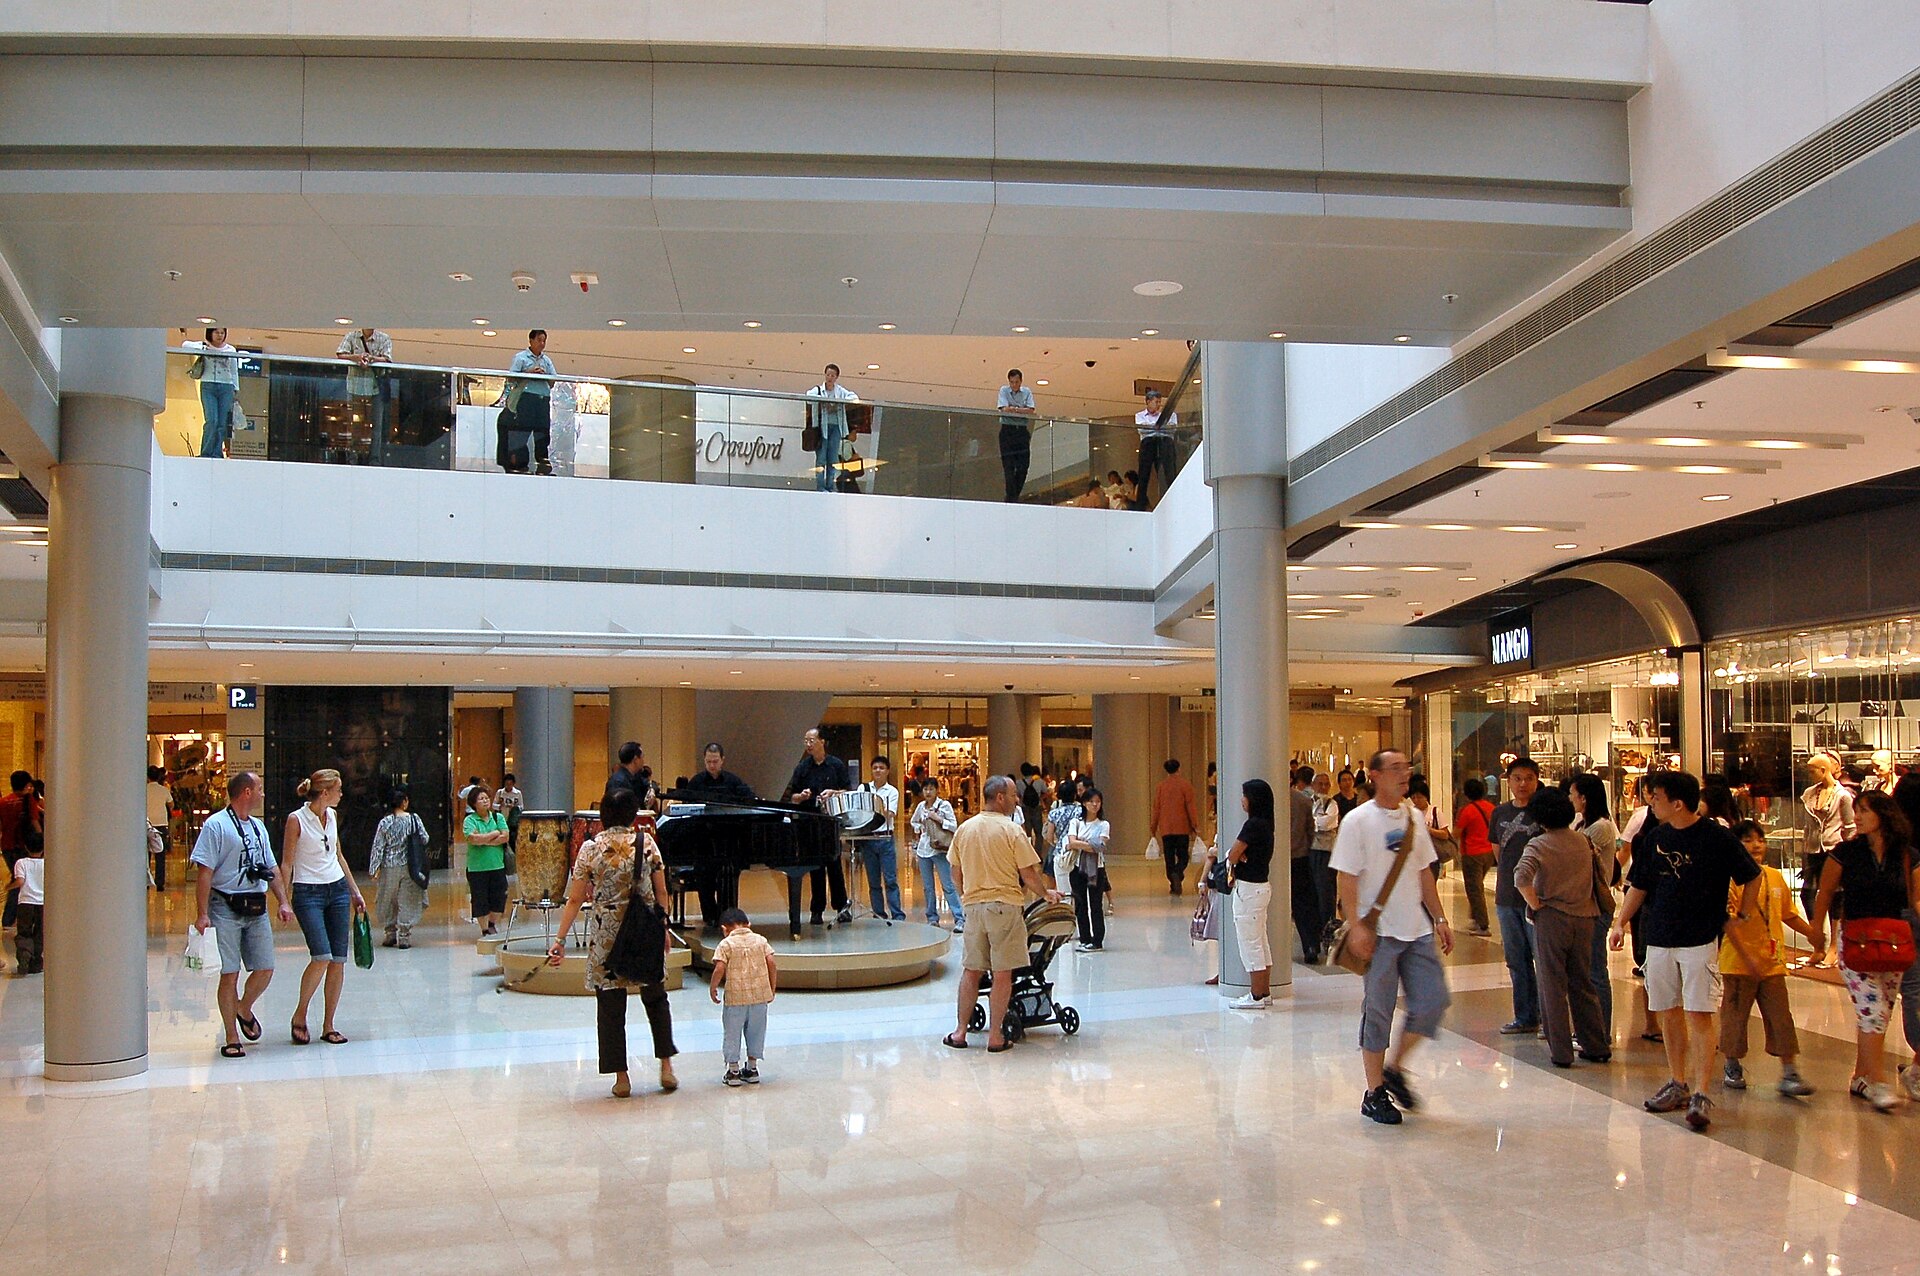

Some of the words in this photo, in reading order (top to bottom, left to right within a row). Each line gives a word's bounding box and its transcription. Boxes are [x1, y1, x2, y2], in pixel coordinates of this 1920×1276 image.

[705, 431, 784, 465] Crawford
[1491, 626, 1529, 665] MANGO
[231, 688, 246, 708] P
[921, 728, 959, 740] ZAR
